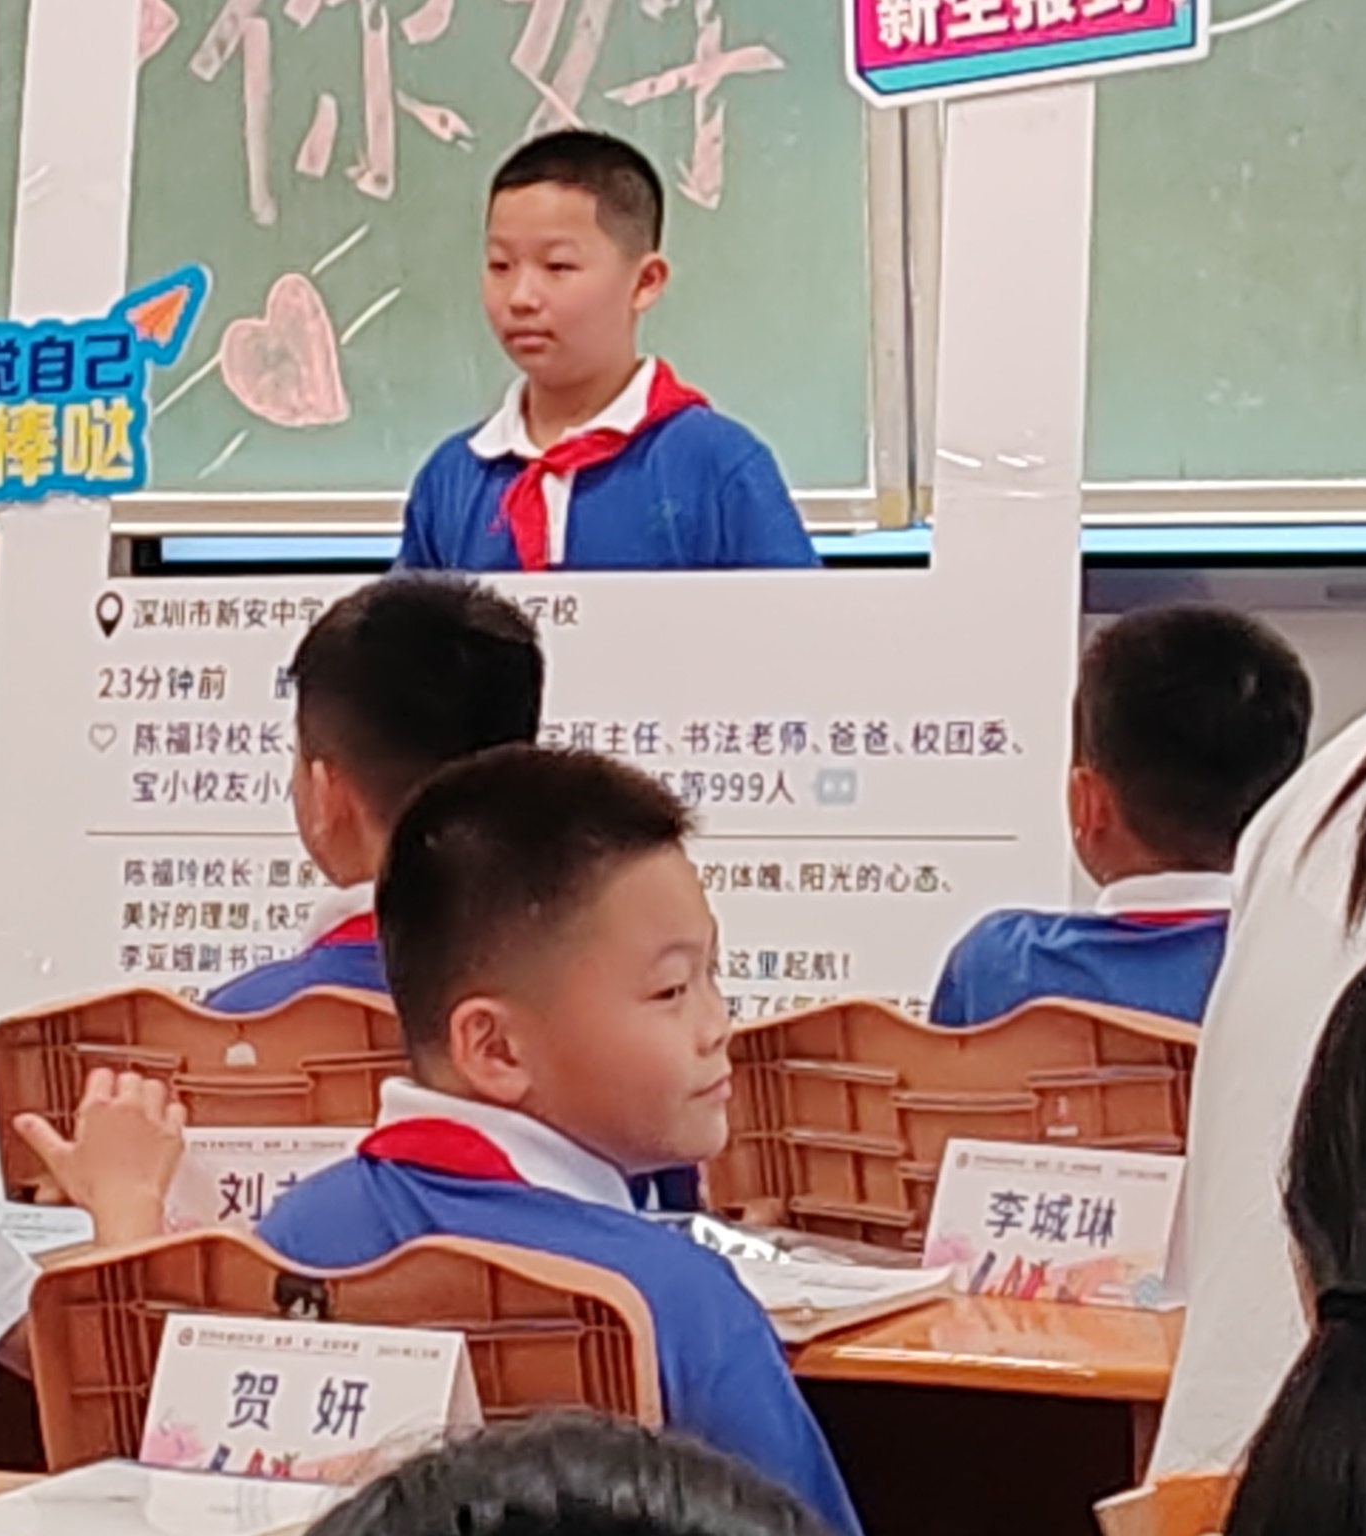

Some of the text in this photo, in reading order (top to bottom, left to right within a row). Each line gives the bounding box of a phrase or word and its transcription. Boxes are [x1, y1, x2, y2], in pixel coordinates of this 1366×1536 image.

[97, 666, 227, 701] 23分钟前
[132, 768, 294, 805] 宝小校友小
[218, 1171, 298, 1222] 刘
